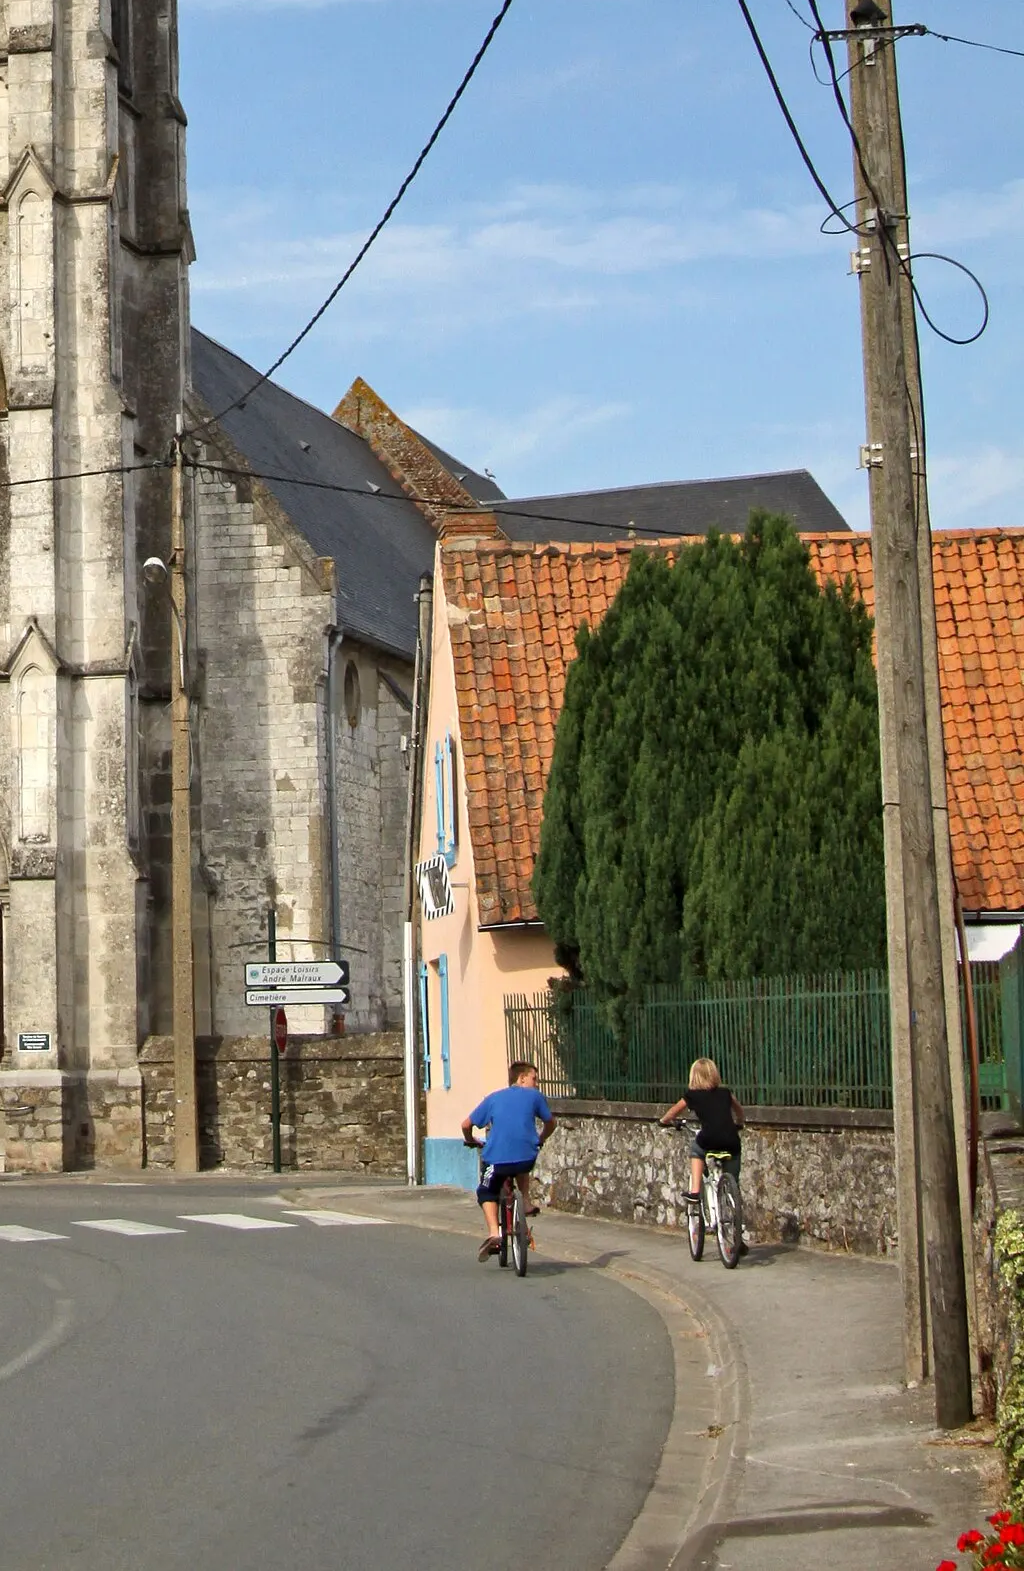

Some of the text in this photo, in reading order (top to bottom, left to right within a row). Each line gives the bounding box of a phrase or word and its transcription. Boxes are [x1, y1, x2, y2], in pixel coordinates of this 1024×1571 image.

[262, 974, 322, 983] André Malraux
[249, 993, 287, 1002] Cimetière
